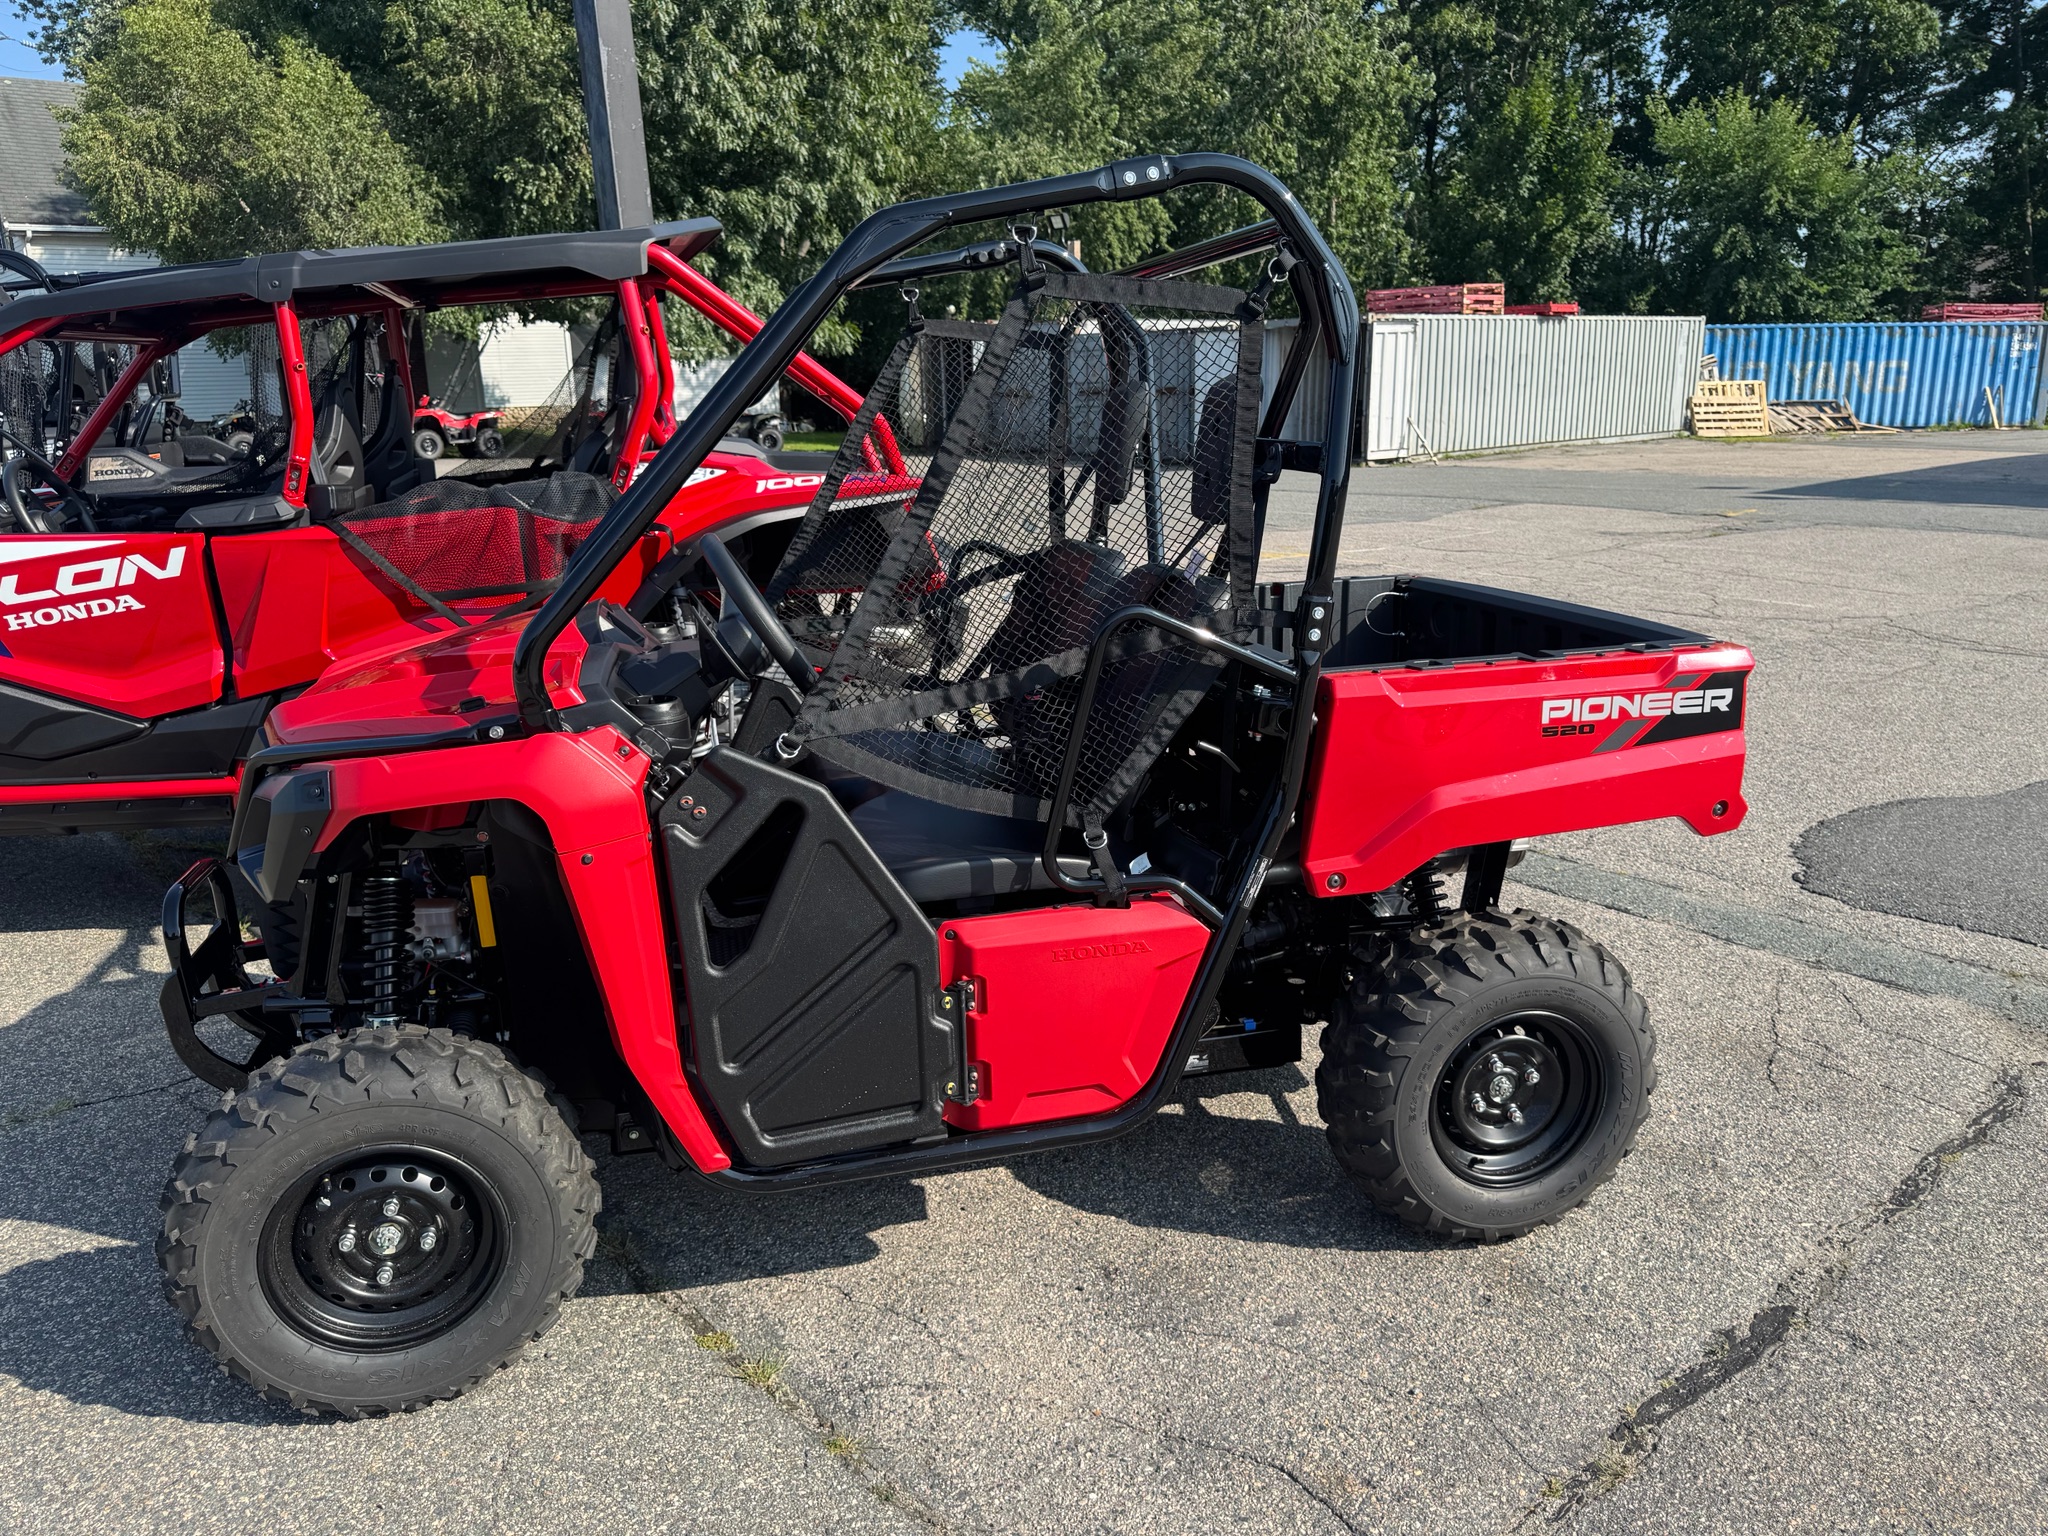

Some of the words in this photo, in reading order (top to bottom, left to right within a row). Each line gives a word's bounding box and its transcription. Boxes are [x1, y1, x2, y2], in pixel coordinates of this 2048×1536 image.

[93, 467, 147, 477] HONDA
[755, 475, 827, 494] 100
[3, 594, 146, 631] HONDA
[1541, 688, 1734, 724] PIONEER
[1541, 723, 1595, 737] 520
[1051, 940, 1153, 963] HONDA
